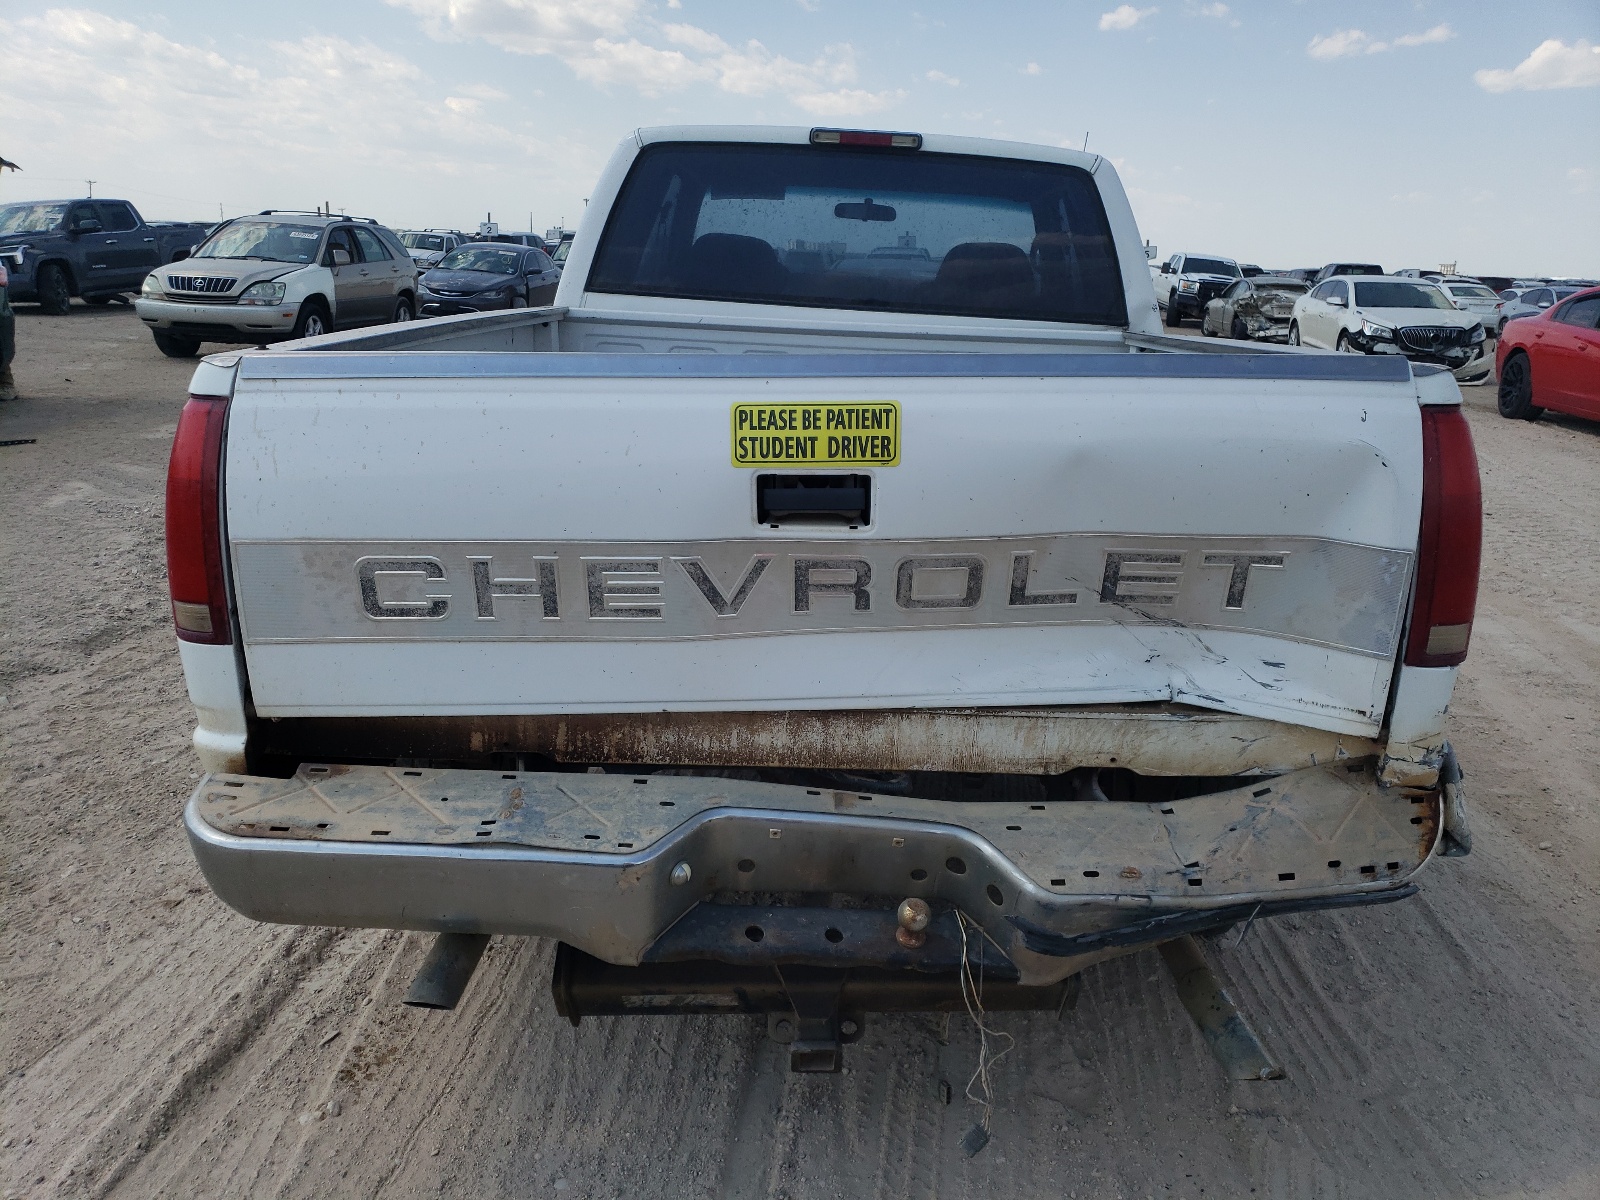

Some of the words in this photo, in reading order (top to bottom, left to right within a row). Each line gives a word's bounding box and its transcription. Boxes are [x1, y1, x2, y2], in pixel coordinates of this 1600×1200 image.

[486, 226, 493, 234] 2
[1144, 250, 1150, 259] 5
[738, 409, 798, 431] PLEASE
[802, 409, 822, 430] BE
[826, 408, 893, 430] PATIENT
[738, 436, 819, 459] STUDENT
[827, 435, 892, 458] DRIVER
[353, 548, 1291, 621] CHEVROLET
